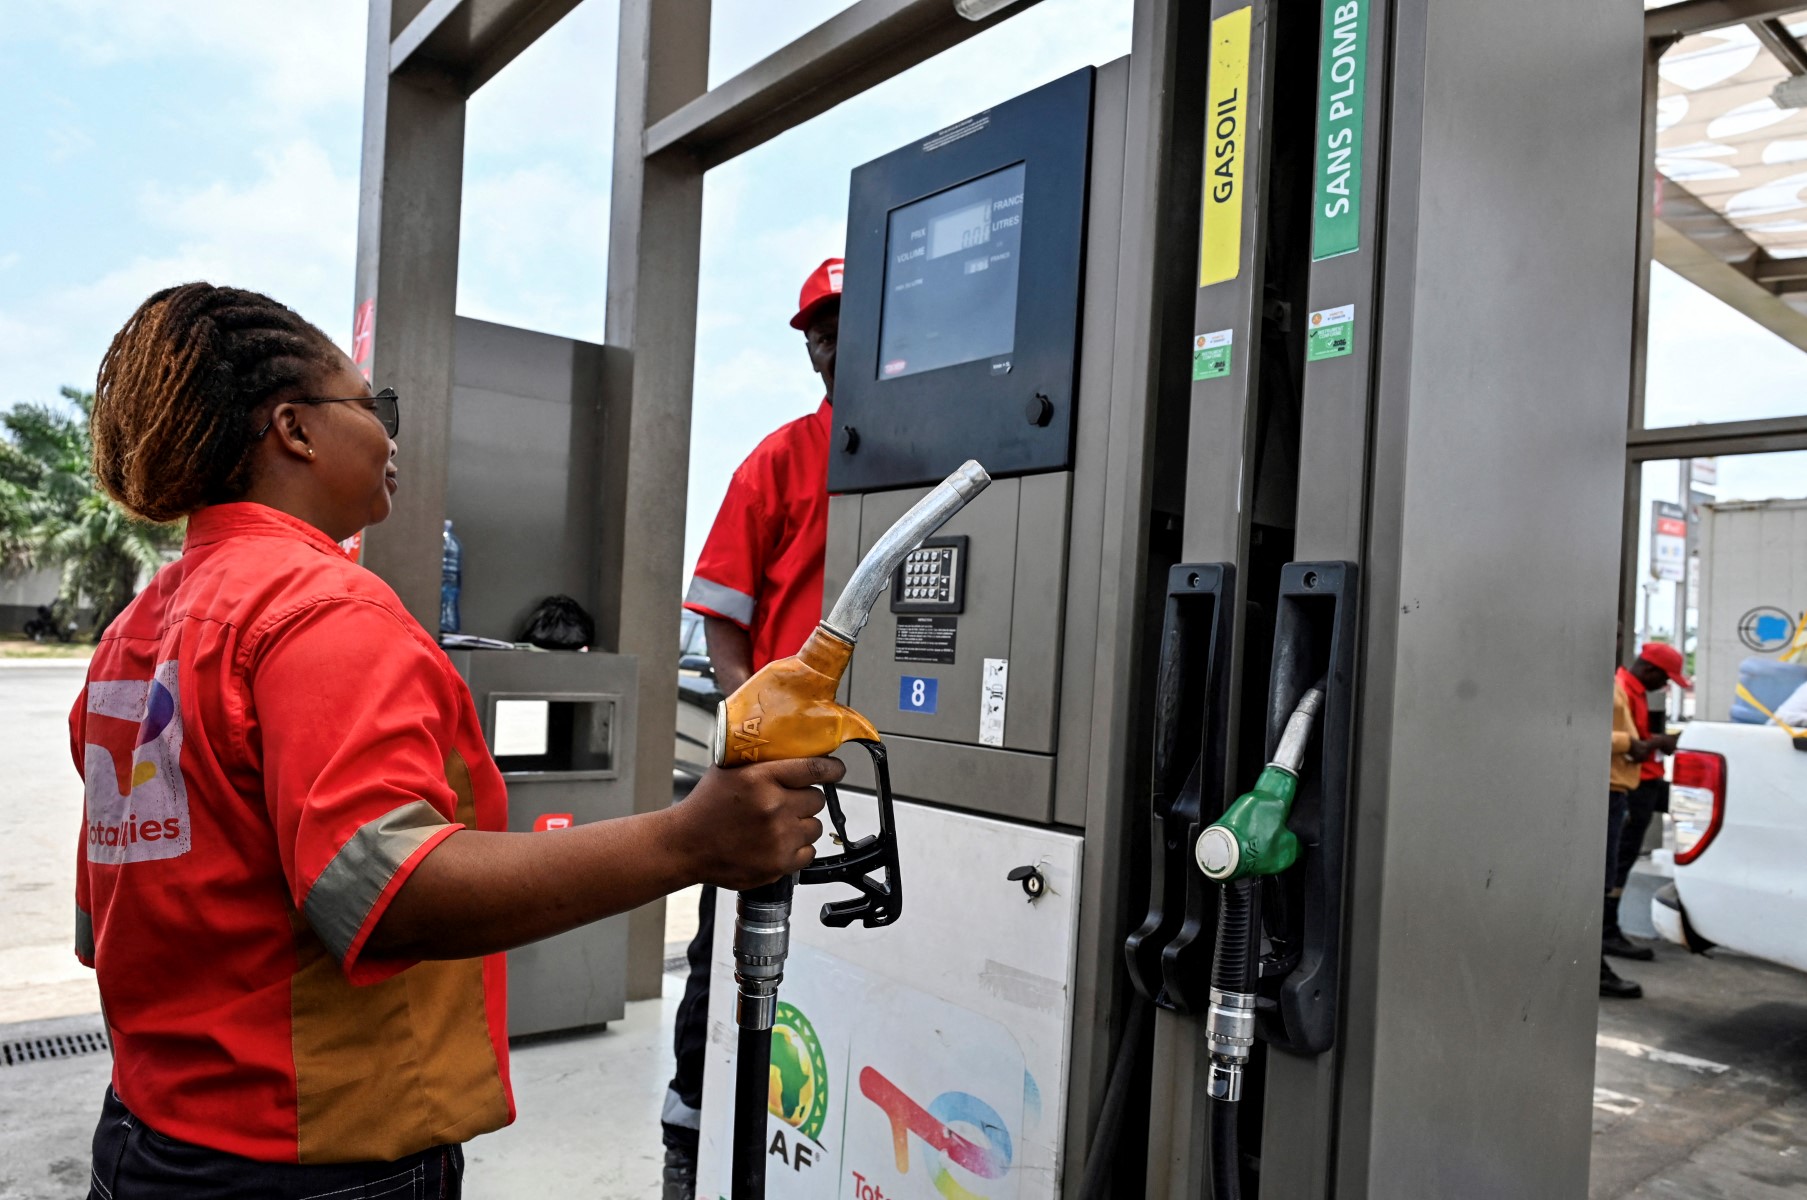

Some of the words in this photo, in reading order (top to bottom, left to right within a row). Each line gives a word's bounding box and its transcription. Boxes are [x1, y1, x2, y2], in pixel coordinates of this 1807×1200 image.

[1329, 0, 1358, 121] PLOMB
[1213, 87, 1238, 203] GASOIL
[1325, 127, 1353, 218] SANS
[911, 228, 926, 240] PRIX
[992, 214, 1020, 232] LITRES
[897, 246, 926, 263] VOLUME
[911, 679, 925, 707] 8
[768, 1129, 813, 1172] AF
[852, 1170, 892, 1200] Tot
